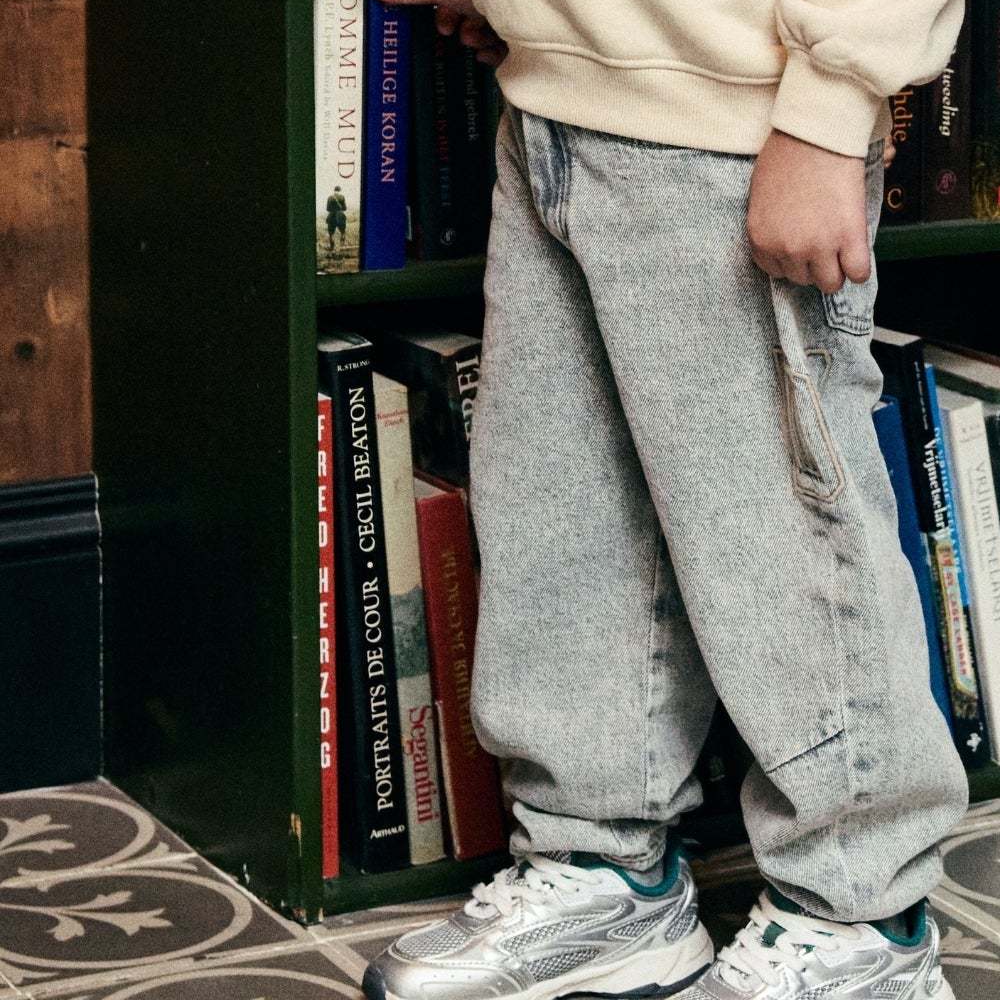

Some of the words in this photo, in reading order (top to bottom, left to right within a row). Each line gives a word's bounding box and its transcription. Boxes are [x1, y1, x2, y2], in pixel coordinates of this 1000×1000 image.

[383, 21, 398, 104] HEILIGE
[337, 108, 356, 180] MUD
[380, 112, 396, 183] KORAN
[349, 387, 373, 482] BEATON
[318, 415, 328, 547] FRED
[357, 485, 375, 553] CECIL
[363, 577, 382, 643] COUR
[318, 566, 331, 769] HERZOG
[367, 647, 384, 679] DE
[370, 684, 394, 812] PORTRAITS
[401, 705, 440, 823] Segantini
[370, 824, 405, 840] ARTHAUD
